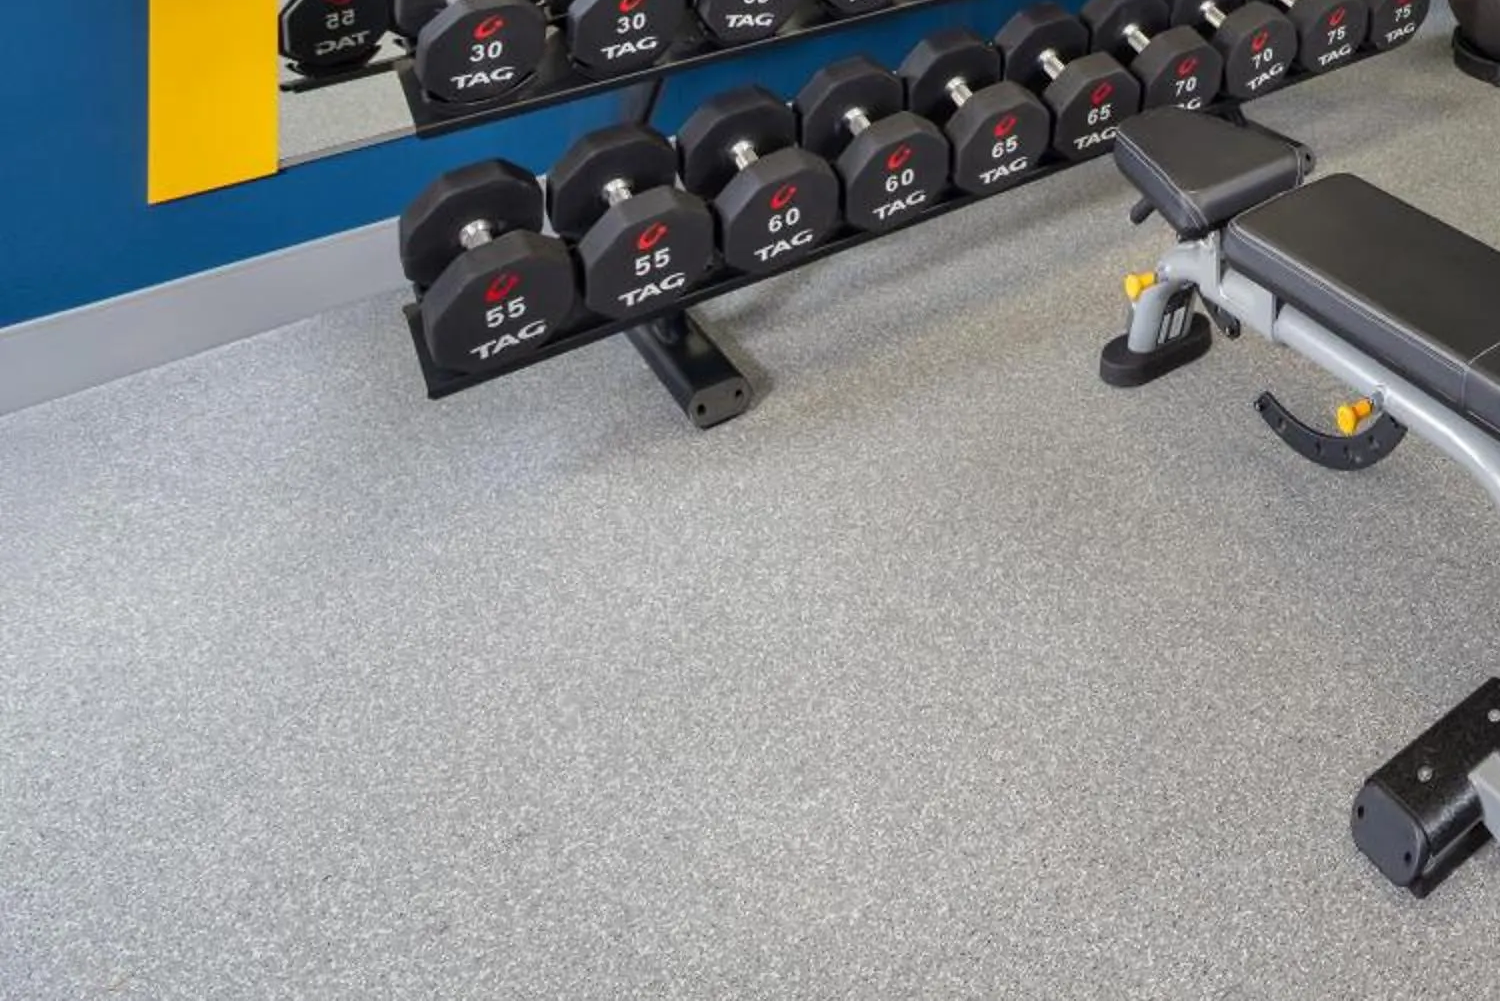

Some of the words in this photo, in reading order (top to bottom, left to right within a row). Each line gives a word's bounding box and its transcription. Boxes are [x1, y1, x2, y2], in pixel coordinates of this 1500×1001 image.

[616, 12, 646, 34] 30
[725, 12, 774, 28] TAG
[1394, 3, 1412, 23] 75
[1327, 25, 1347, 46] 75
[1384, 22, 1416, 45] TAG
[469, 40, 503, 62] 30
[600, 36, 658, 60] TAG
[1252, 47, 1274, 71] 70
[1317, 42, 1352, 68] TAG
[450, 66, 514, 90] TAG
[1175, 76, 1197, 97] 70
[1247, 61, 1284, 92] TAG
[1087, 103, 1112, 126] 65
[991, 134, 1018, 159] 65
[1073, 126, 1118, 150] TAG
[885, 168, 916, 193] 60
[979, 156, 1029, 186] TAG
[872, 189, 927, 220] TAG
[767, 207, 801, 233] 60
[753, 228, 813, 262] TAG
[635, 246, 671, 277] 55
[618, 271, 685, 307] TAG
[485, 296, 526, 329] 55
[469, 319, 547, 361] TAG
